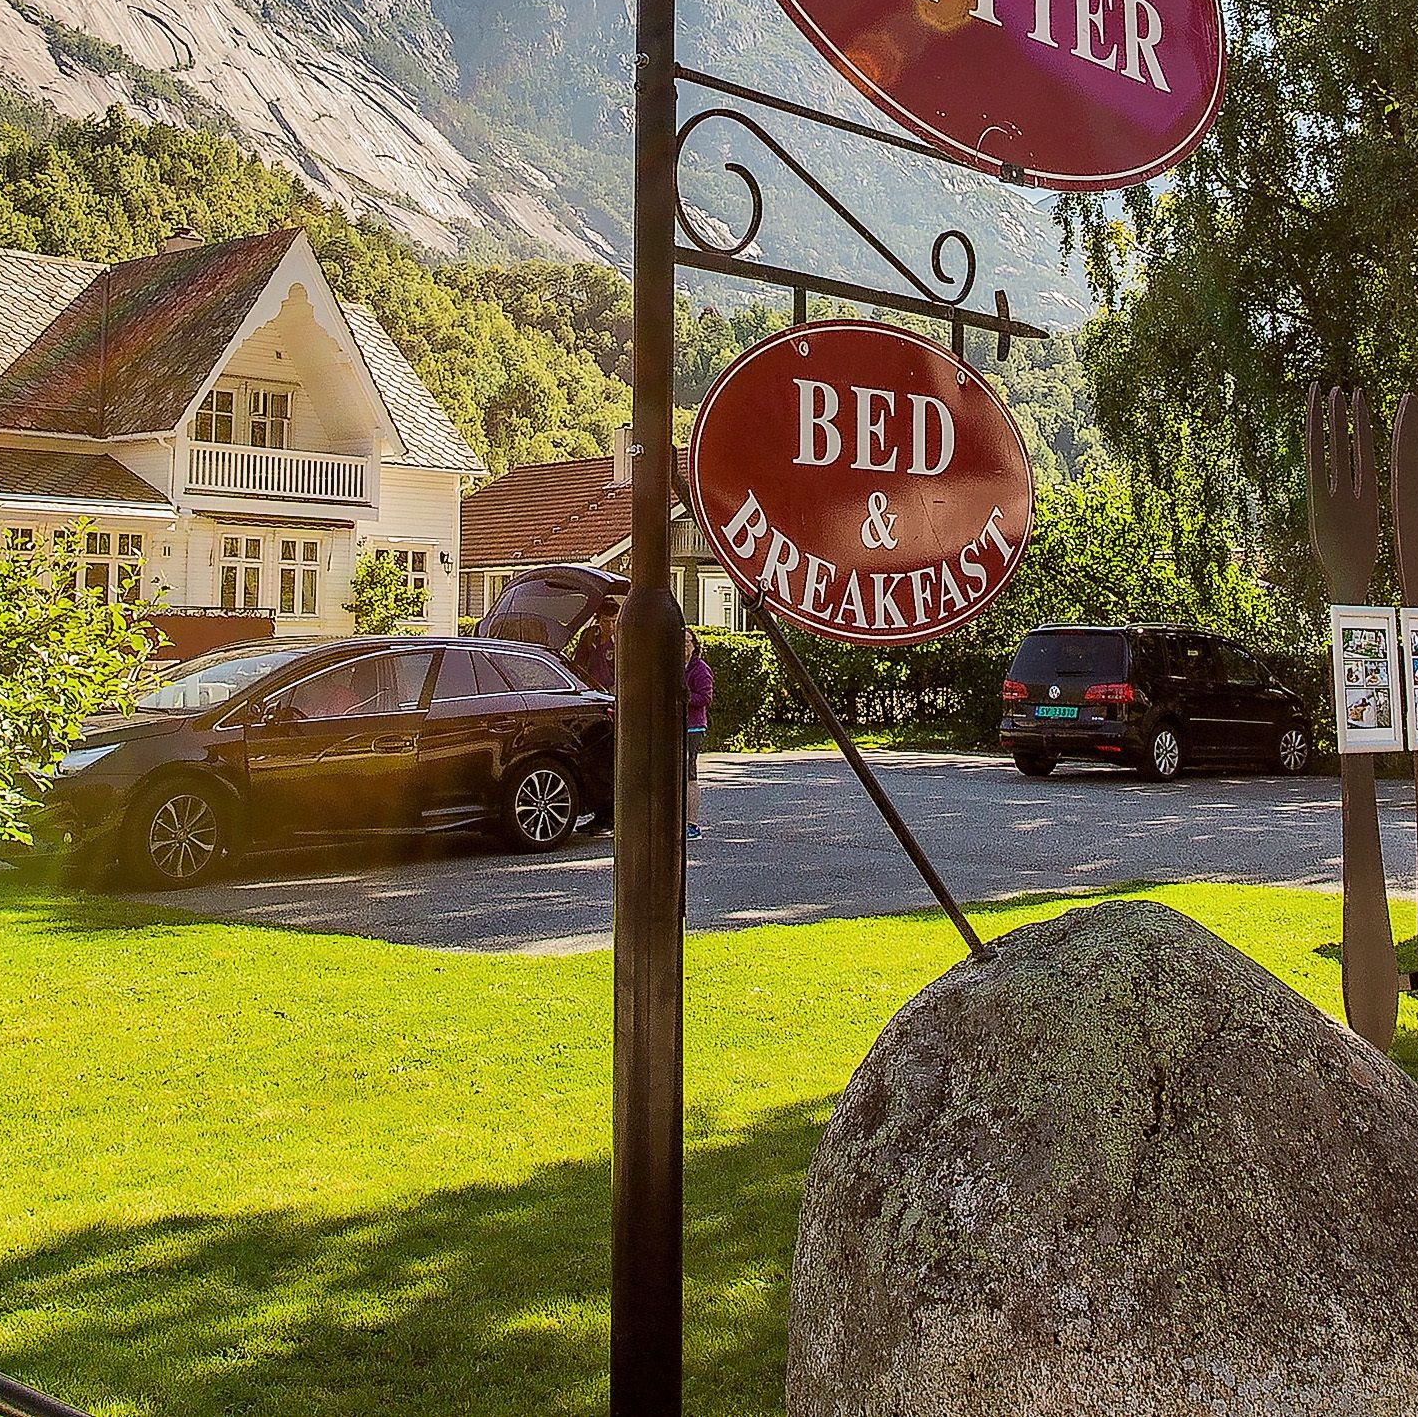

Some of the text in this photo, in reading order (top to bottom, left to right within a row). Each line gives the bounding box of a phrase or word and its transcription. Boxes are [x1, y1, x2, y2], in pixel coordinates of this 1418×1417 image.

[792, 378, 955, 475] BED
[721, 489, 1016, 630] BREAKFAST
[861, 491, 899, 550] &
